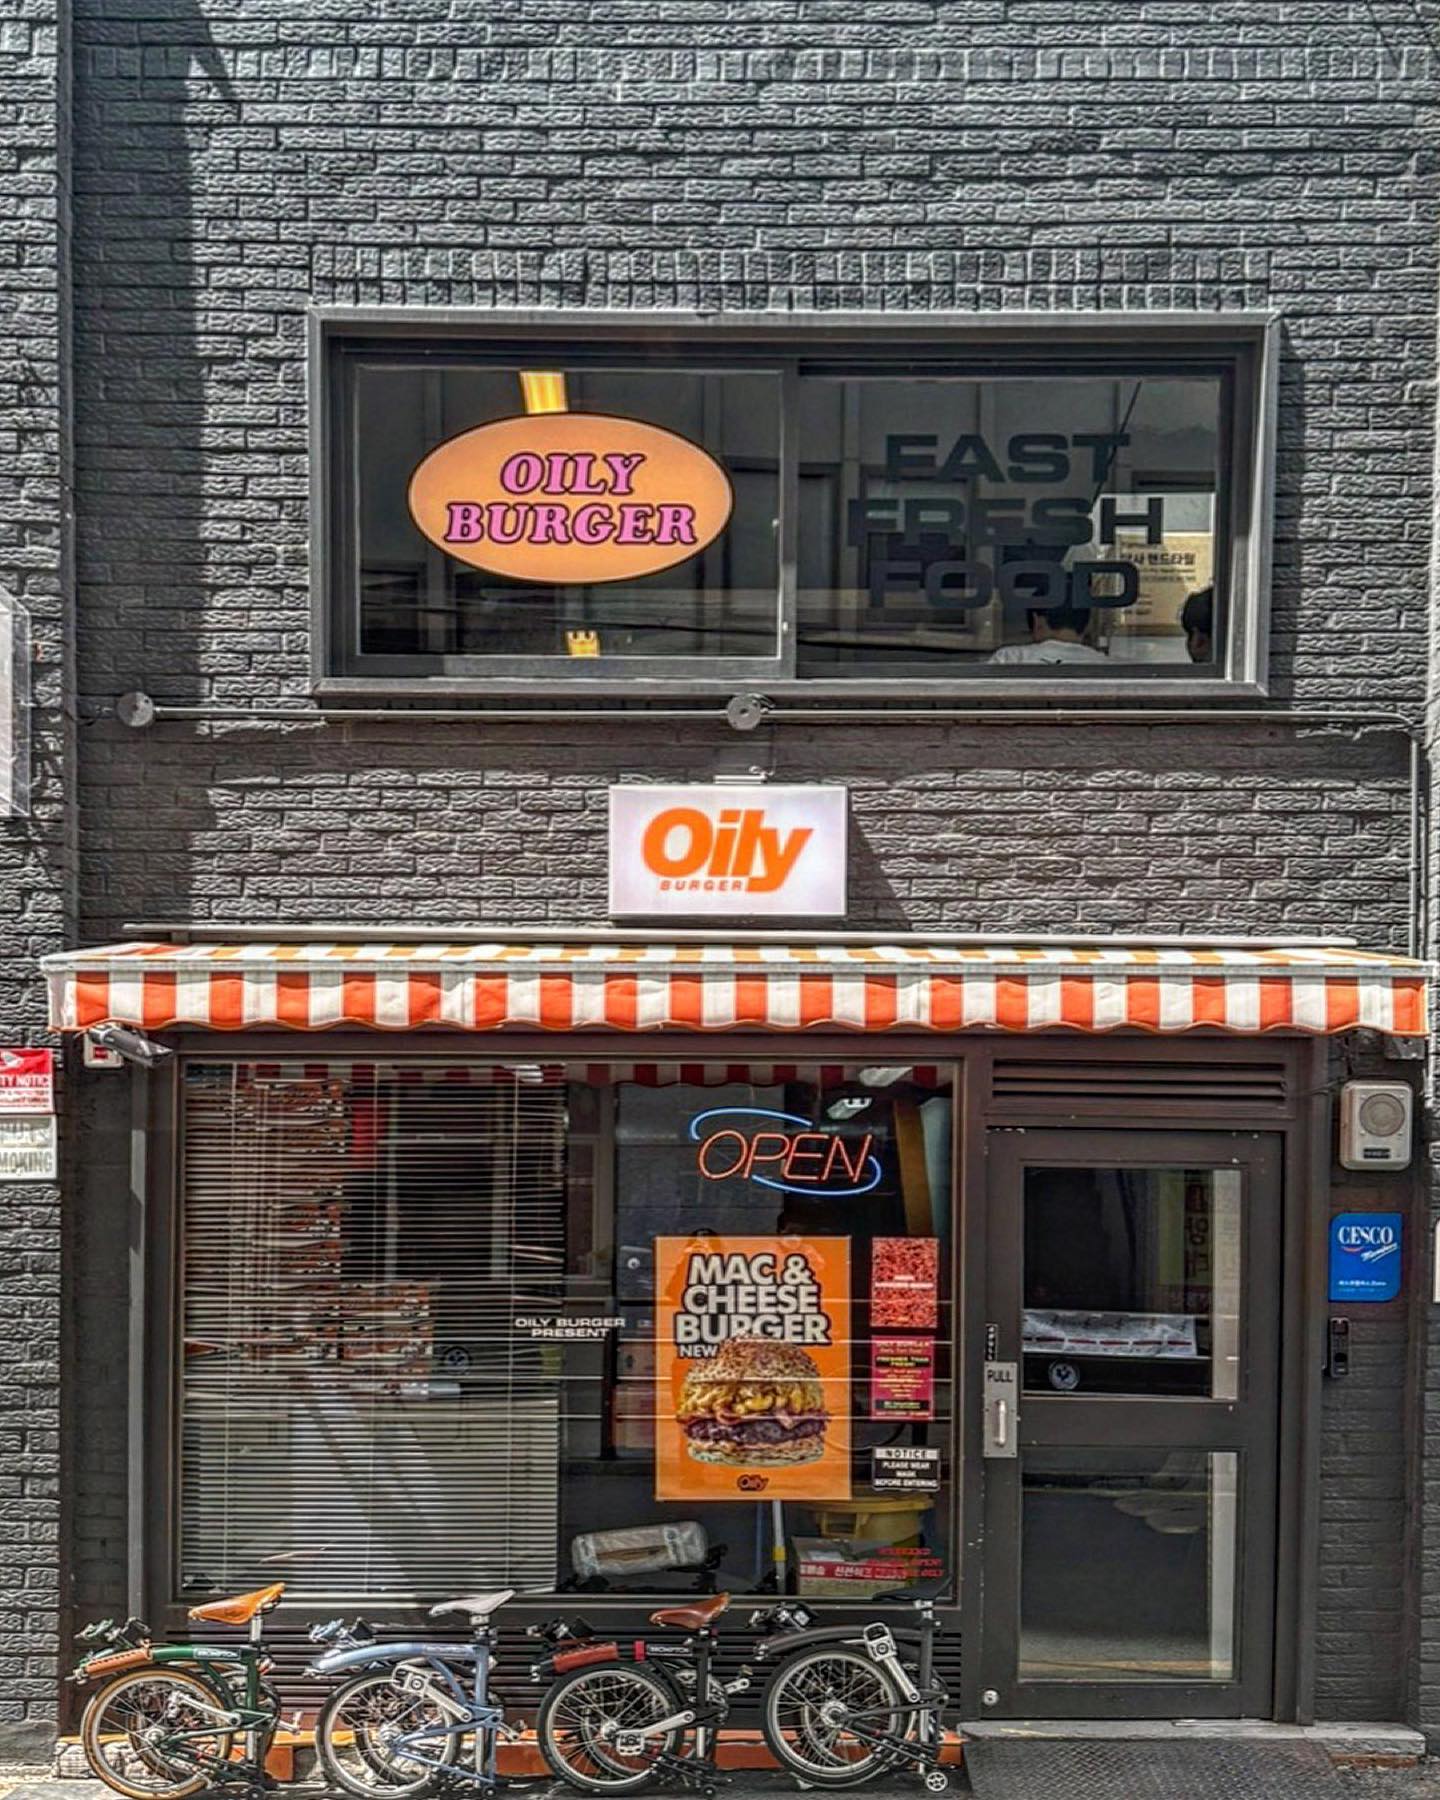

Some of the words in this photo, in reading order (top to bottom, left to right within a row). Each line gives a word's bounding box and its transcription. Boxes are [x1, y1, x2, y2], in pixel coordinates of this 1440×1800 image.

[501, 453, 645, 495] OILY
[444, 501, 697, 544] BURGER
[848, 498, 1163, 546] FRESH
[870, 561, 1140, 609] FOOD
[641, 807, 814, 893] Oily
[660, 880, 742, 891] BURGER
[699, 1129, 872, 1183] OPEN
[1338, 1226, 1394, 1244] CESCO
[689, 1253, 777, 1286] MAC
[783, 1253, 814, 1285] &
[683, 1285, 820, 1316] CHEESE
[515, 1318, 551, 1327] OILY
[556, 1317, 625, 1327] BURGER
[531, 1328, 609, 1337] PRESENT
[675, 1314, 831, 1345] BURGER
[680, 1345, 718, 1357] NEW
[987, 1369, 1014, 1383] PULL
[882, 1461, 909, 1469] PLEASE
[886, 1449, 927, 1458] NOTICE
